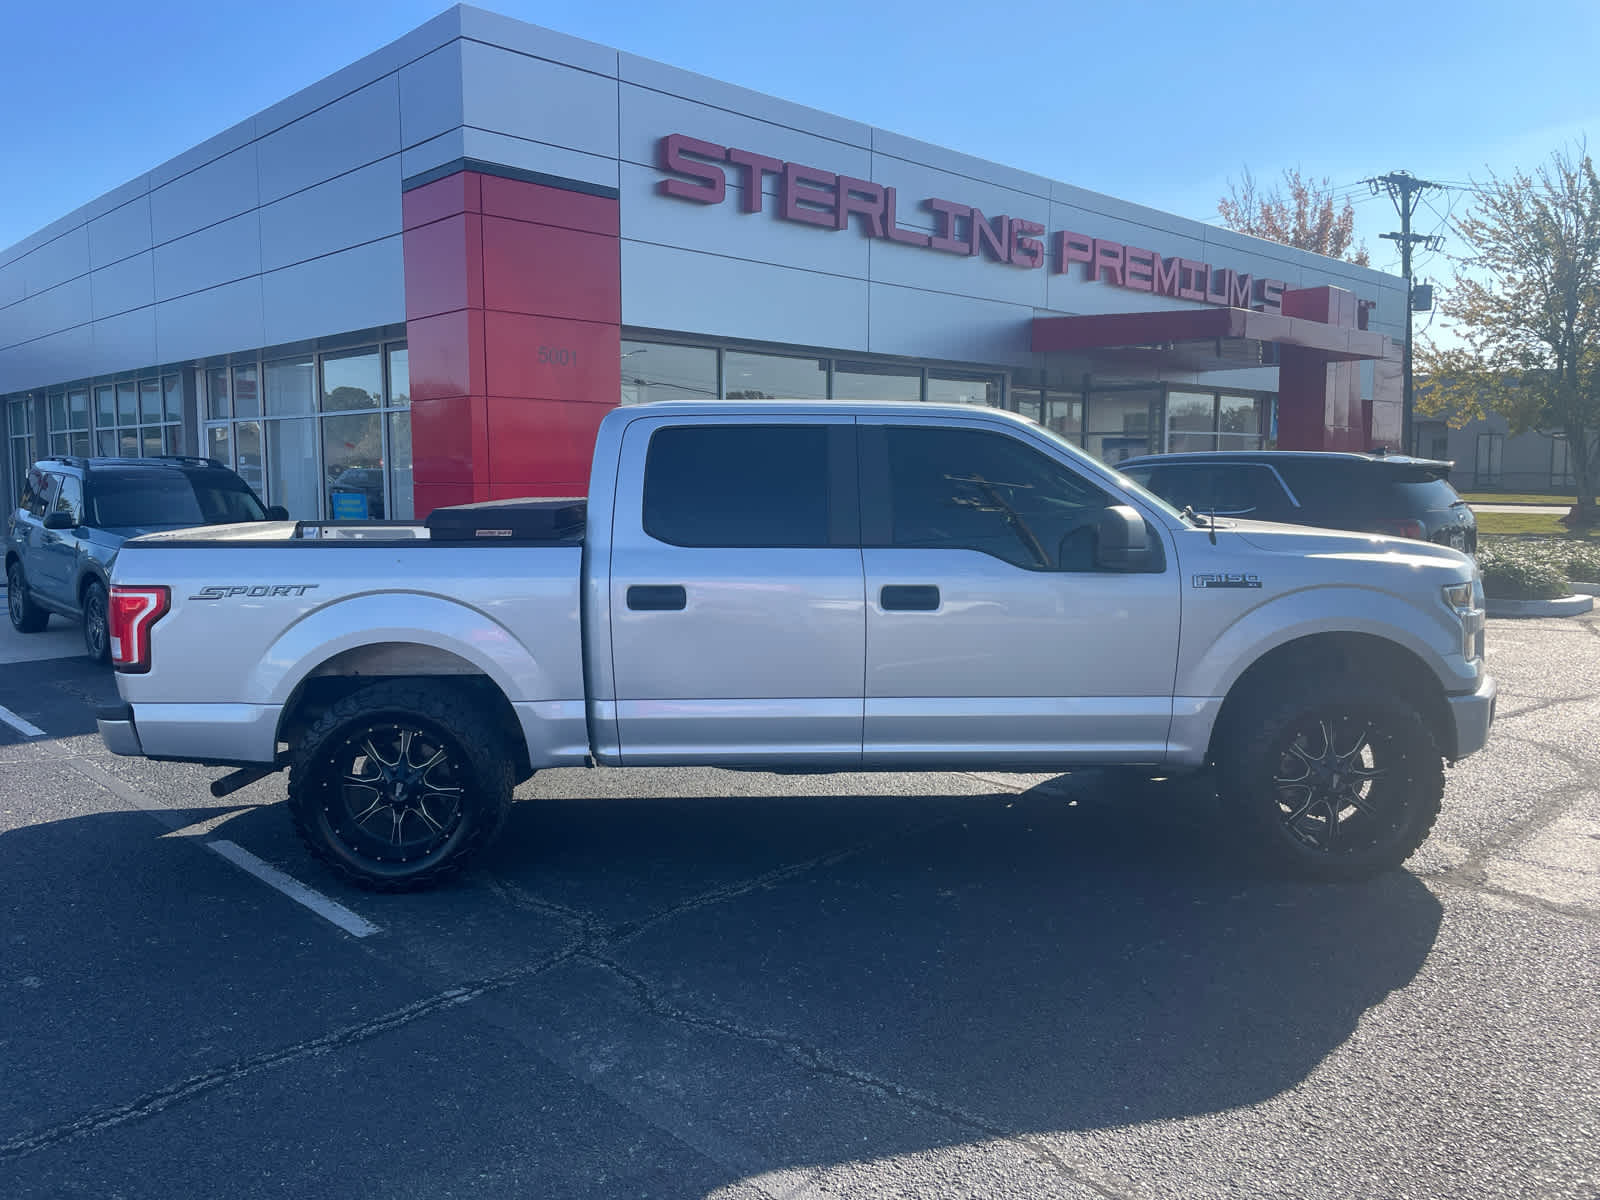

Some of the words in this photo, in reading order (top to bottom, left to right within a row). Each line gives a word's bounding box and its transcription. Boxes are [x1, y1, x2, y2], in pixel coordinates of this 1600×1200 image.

[657, 133, 1045, 268] STERLING
[1056, 230, 1252, 309] PREMIUM
[188, 584, 320, 600] SPORT
